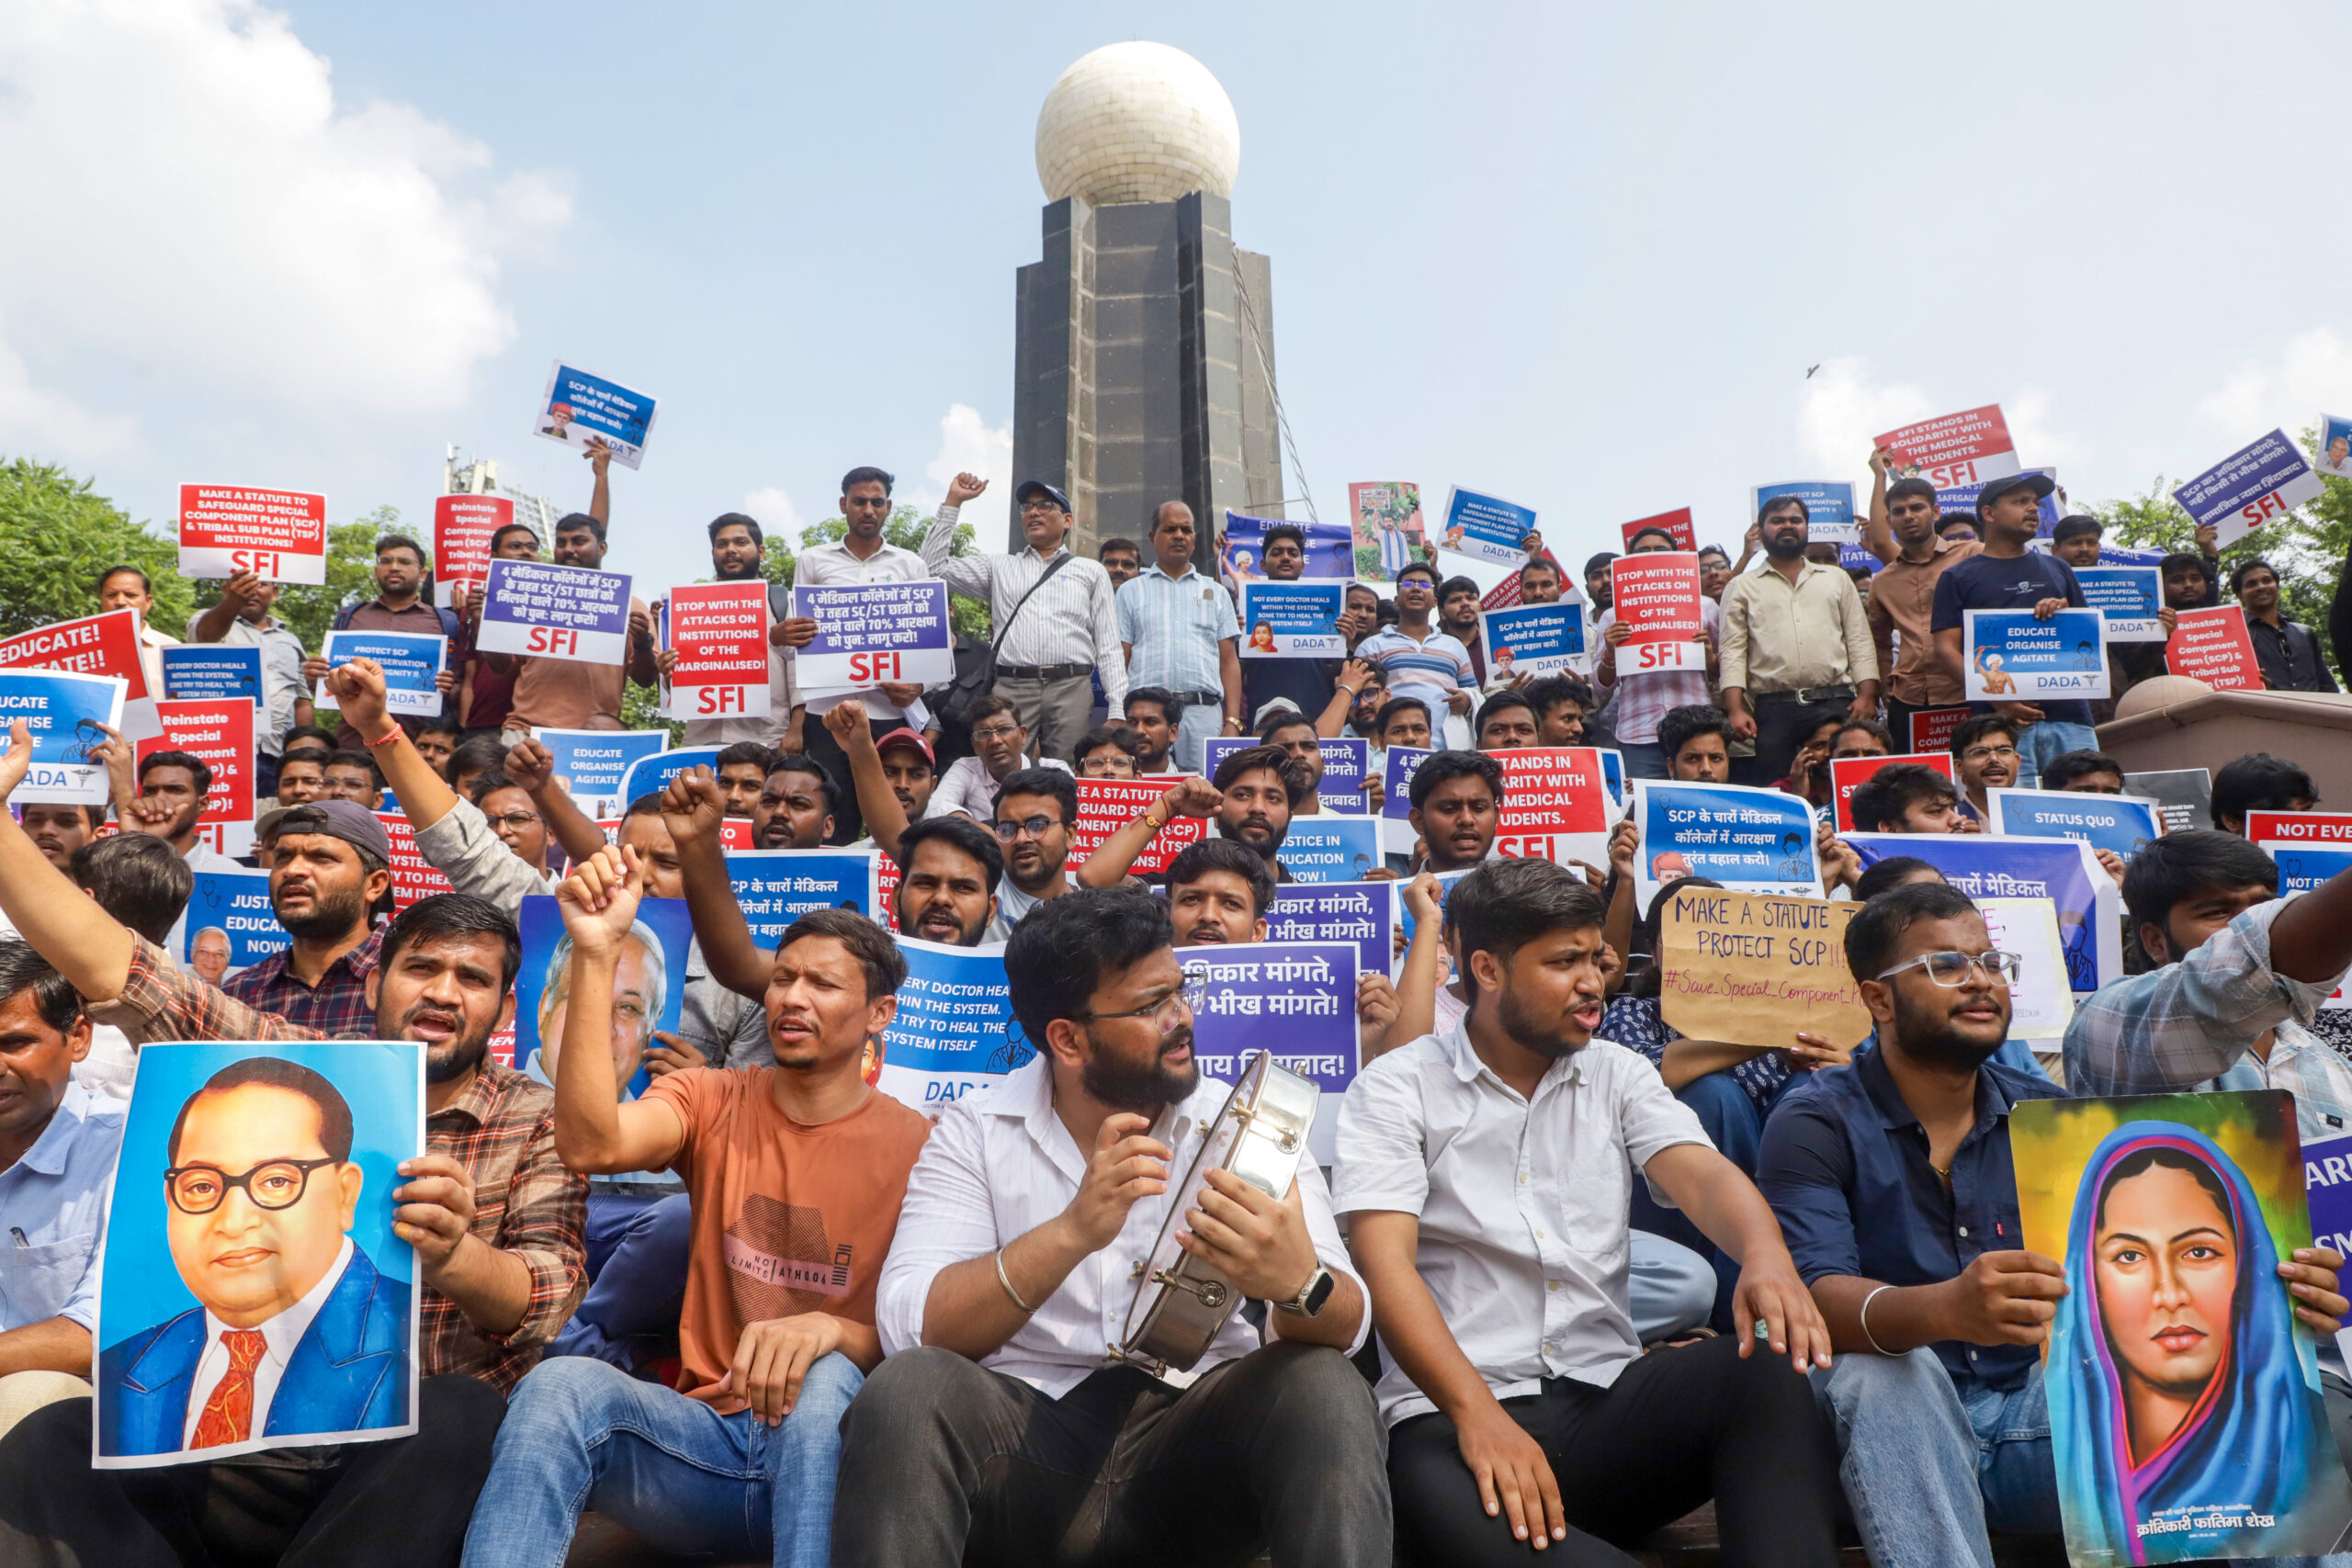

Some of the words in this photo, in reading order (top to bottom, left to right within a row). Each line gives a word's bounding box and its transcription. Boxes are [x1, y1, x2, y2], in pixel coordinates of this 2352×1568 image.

[1897, 429, 1915, 438] SFI
[1916, 417, 1963, 433] STANDS
[1965, 413, 1978, 422] IN
[1890, 428, 1958, 449] SOLIDARITY
[1960, 420, 1992, 434] WITH
[1905, 446, 1928, 457] THE
[1929, 434, 1984, 451] MEDICAL
[1915, 446, 1980, 466] STUDENTS.
[1930, 461, 1978, 489] SFI
[199, 490, 232, 499] MAKE
[234, 491, 243, 500] A
[244, 492, 292, 504] STATUTE
[293, 497, 309, 505] TO
[198, 501, 265, 513] SAFEGUARD
[267, 506, 310, 516] SPECIAL
[2243, 491, 2287, 527] SFI
[185, 511, 258, 523] COMPONENT
[261, 516, 288, 525] PLAN
[290, 516, 320, 531] (SCP)
[186, 522, 195, 530] &
[197, 522, 236, 533] TRIBAL
[238, 525, 260, 534] SUB
[262, 527, 289, 536] PLAN
[291, 529, 320, 541] (TSP)
[215, 535, 293, 547] INSTITUTIONS!
[1483, 545, 1511, 558] DADA
[230, 550, 278, 578] SFI
[1616, 570, 1643, 582] STOP
[1645, 569, 1674, 578] WITH
[1675, 568, 1695, 577] THE
[1623, 581, 1672, 594] ATTACKS
[1673, 581, 1690, 590] ON
[808, 593, 815, 604] 4
[816, 590, 859, 604] मेडिकल
[860, 588, 899, 603] कॉलेजों
[899, 587, 911, 600] में
[912, 588, 933, 600] SCP
[1621, 594, 1693, 607] INSTITUTIONS
[675, 602, 706, 612] STOP
[707, 601, 739, 610] WITH
[741, 599, 763, 609] THE
[813, 605, 824, 619] के
[826, 606, 849, 618] तहत
[852, 604, 885, 618] SC/ST
[915, 600, 929, 614] को
[1639, 608, 1654, 618] OF
[1656, 607, 1676, 616] THE
[682, 615, 736, 626] ATTACKS
[738, 615, 756, 624] ON
[843, 617, 865, 631] वाले
[868, 618, 893, 630] 70%
[897, 615, 937, 628] आरक्षण
[2109, 623, 2143, 632] DADA
[2177, 618, 2226, 630] Reinstate
[679, 629, 759, 641] INSTITUTIONS
[827, 635, 842, 647] को
[867, 633, 892, 648] लागू
[892, 631, 918, 643] करो!
[2007, 627, 2057, 637] EDUCATE
[2186, 630, 2223, 643] Special
[526, 626, 578, 655] SFI
[1293, 638, 1325, 648] DADA
[2006, 641, 2062, 650] ORGANISE
[2177, 640, 2238, 654] Component
[355, 646, 392, 655] PROTECT
[699, 646, 716, 655] OF
[718, 645, 740, 655] THE
[1639, 642, 1682, 669] SFI
[674, 660, 765, 671] MARGINALISED!
[1537, 659, 1569, 671] DADA
[2012, 654, 2056, 662] AGITATE
[2179, 658, 2203, 667] Plan
[2204, 651, 2233, 665] (SCP)
[849, 652, 900, 682] SFI
[2188, 669, 2219, 677] Tribal
[2220, 665, 2240, 674] Sub
[2037, 676, 2081, 688] DADA
[2214, 675, 2245, 688] (TSP)!
[697, 686, 744, 714] SFI
[163, 713, 228, 727] Reinstate
[170, 729, 220, 745] Special
[573, 748, 623, 758] EDUCATE
[571, 761, 626, 772] ORGANISE
[1556, 756, 1571, 768] IN
[575, 775, 618, 784] AGITATE
[1546, 774, 1586, 787] WITH
[1091, 787, 1100, 798] A
[1103, 788, 1163, 800] STATUTE
[1504, 793, 1572, 807] MEDICAL
[1668, 810, 1696, 822] SCP
[1699, 808, 1711, 822] के
[1713, 808, 1736, 823] चारों
[1739, 810, 1782, 825] मेडिकल
[2035, 812, 2084, 825] STATUS
[2086, 815, 2115, 828] QUO
[1159, 822, 1200, 840] (SCP)
[1675, 829, 1716, 843] कॉलेजों
[1720, 829, 1731, 844] में
[1732, 833, 1776, 845] आरक्षण
[2276, 823, 2317, 837] NOT
[1681, 851, 1706, 868] तुरंत
[1709, 852, 1740, 866] बहाल
[752, 878, 763, 893] के
[766, 878, 791, 893] चारों
[794, 877, 838, 892] मेडिकल
[1985, 873, 2047, 897] मेडिकल
[2287, 878, 2312, 888] NOT
[1318, 892, 1374, 916] मांगते,
[1675, 896, 1731, 924] MAKE
[1741, 901, 1752, 925] A
[1763, 901, 1829, 930] STATUTE
[1275, 919, 1316, 940] भीख
[1319, 919, 1376, 939] मांगते!
[247, 940, 286, 953] NOW
[1697, 931, 1775, 958] PROTECT
[1264, 955, 1336, 986] मांगते,
[932, 982, 984, 997] DOCTOR
[924, 999, 952, 1013] THE
[953, 1004, 1001, 1015] SYSTEM.
[1208, 987, 1262, 1016] भीख
[1267, 987, 1339, 1016] मांगते!
[900, 1014, 926, 1029] TRY
[930, 1020, 946, 1032] TO
[949, 1021, 979, 1033] HEAL
[983, 1022, 1006, 1033] THE
[882, 1030, 936, 1050] SYSTEM
[938, 1039, 978, 1051] ITSELF
[731, 1256, 769, 1279] LIMITS
[753, 1255, 770, 1267] NO
[2136, 1515, 2191, 1539] क्रांतिकारी
[2194, 1513, 2242, 1529] फातिमा
[2245, 1512, 2276, 1528] शेख
